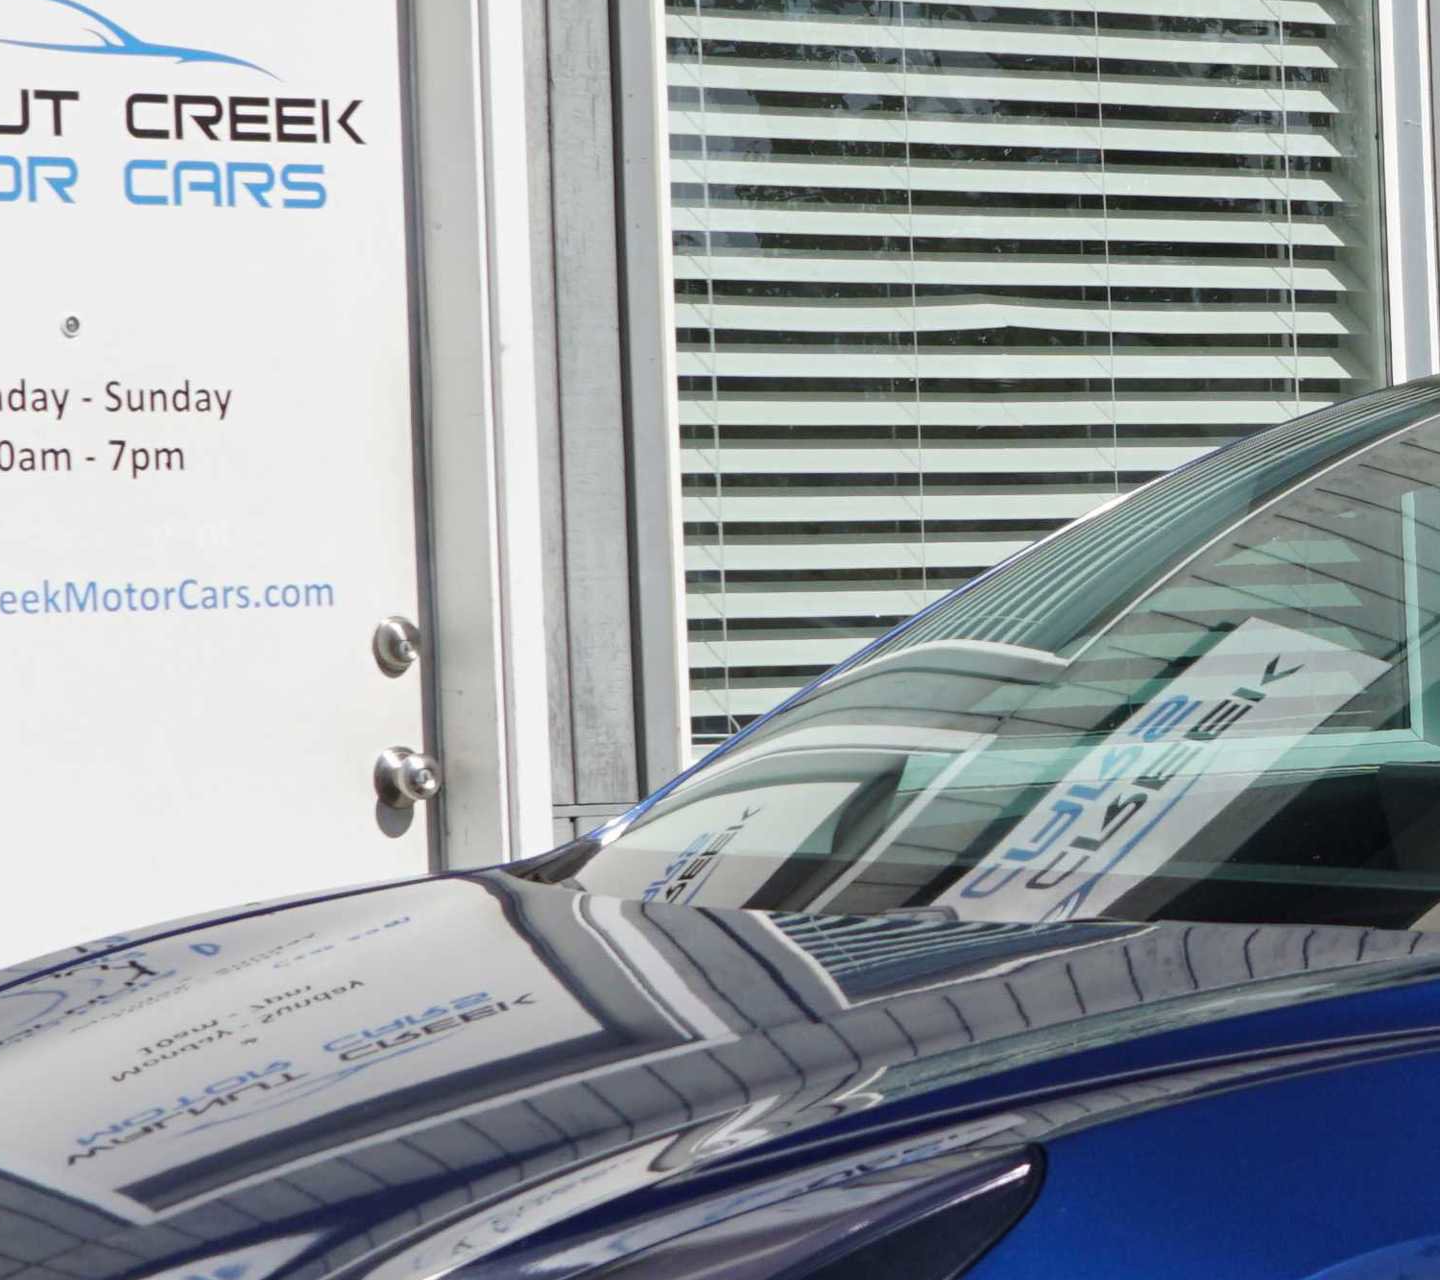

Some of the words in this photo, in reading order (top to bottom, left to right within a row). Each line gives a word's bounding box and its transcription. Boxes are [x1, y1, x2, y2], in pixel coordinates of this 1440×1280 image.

[124, 92, 366, 145] CREEK
[122, 159, 328, 210] CARS
[104, 378, 232, 421] Sunday
[107, 438, 186, 479] 7pm
